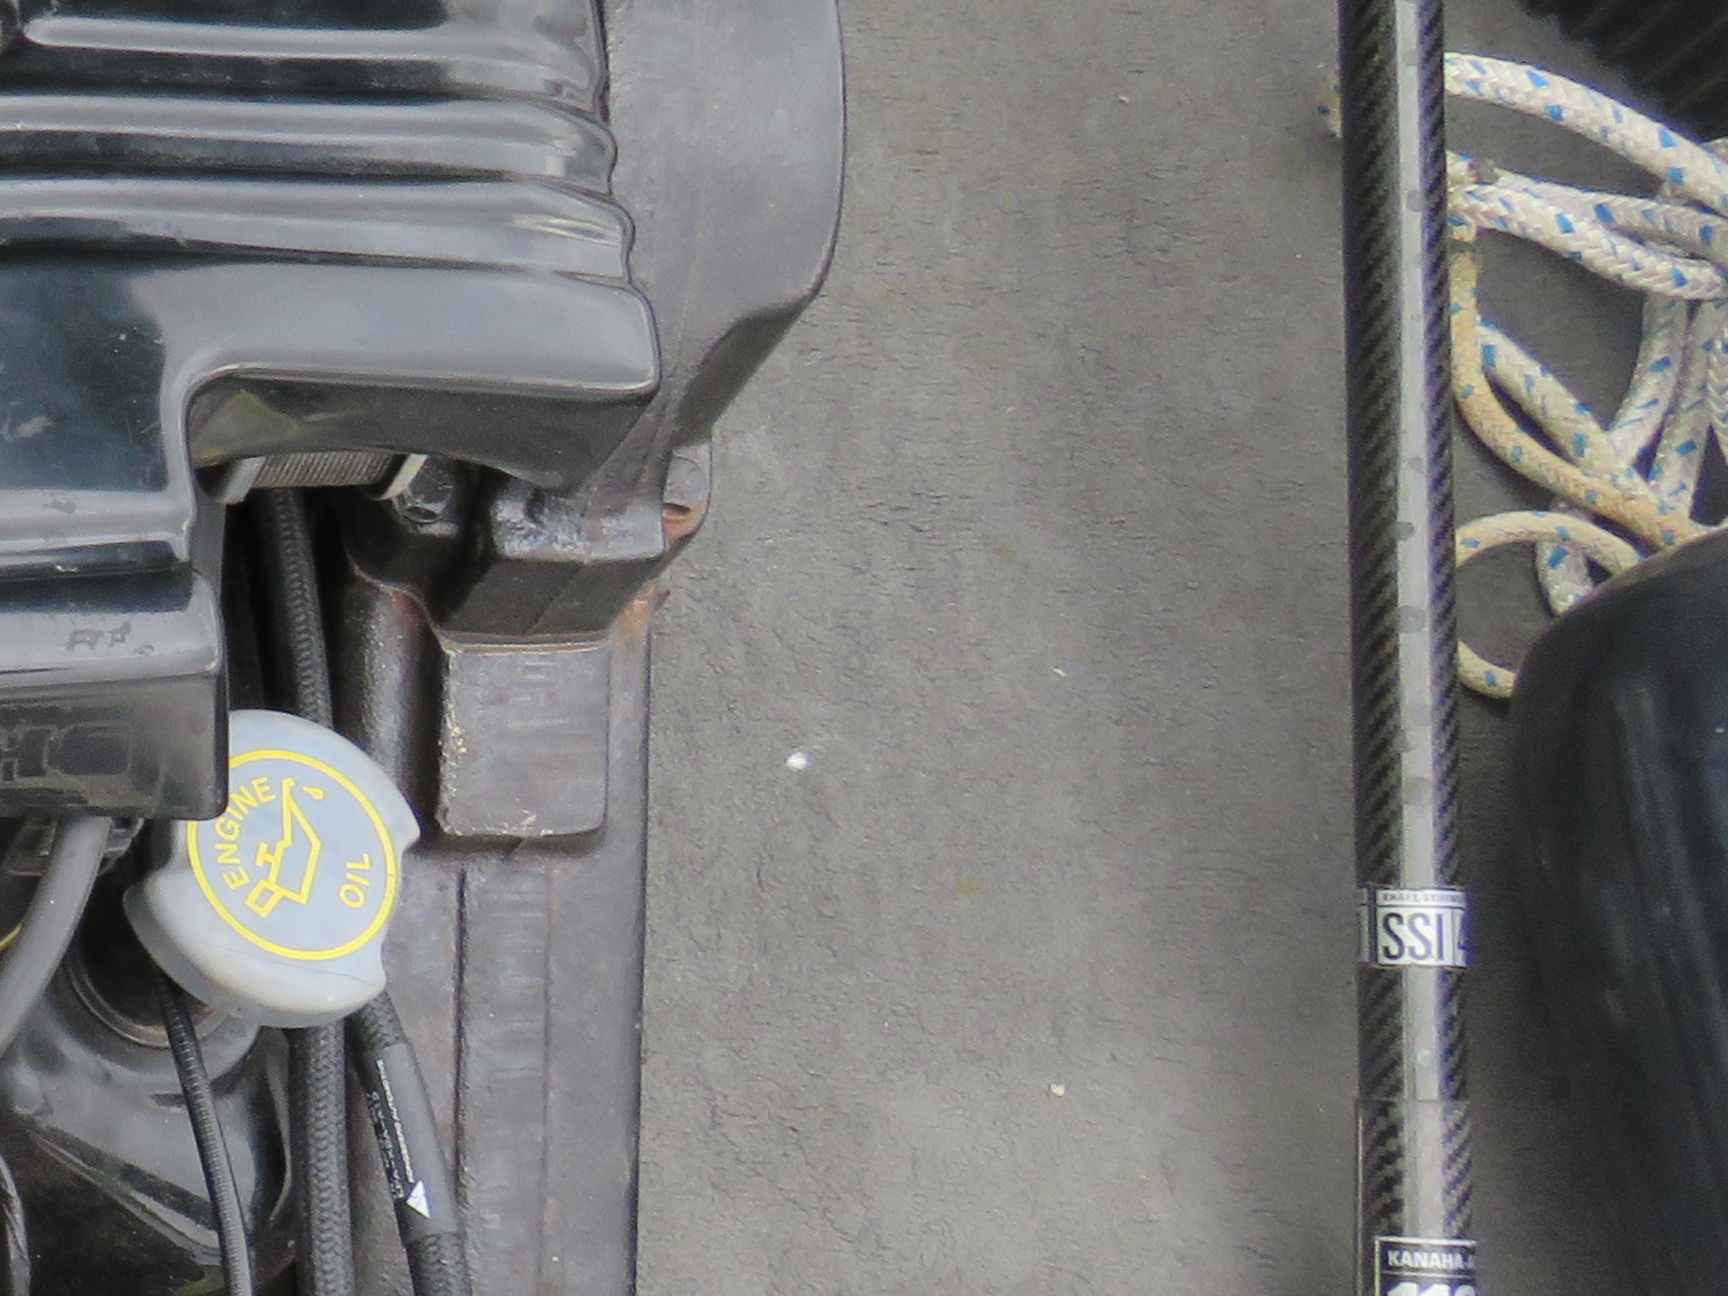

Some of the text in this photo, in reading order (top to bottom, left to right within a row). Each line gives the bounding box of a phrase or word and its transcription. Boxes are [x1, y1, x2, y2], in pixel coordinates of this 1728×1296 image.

[214, 775, 277, 891] ENGINE
[339, 851, 373, 908] OIL
[1382, 911, 1446, 962] SSI
